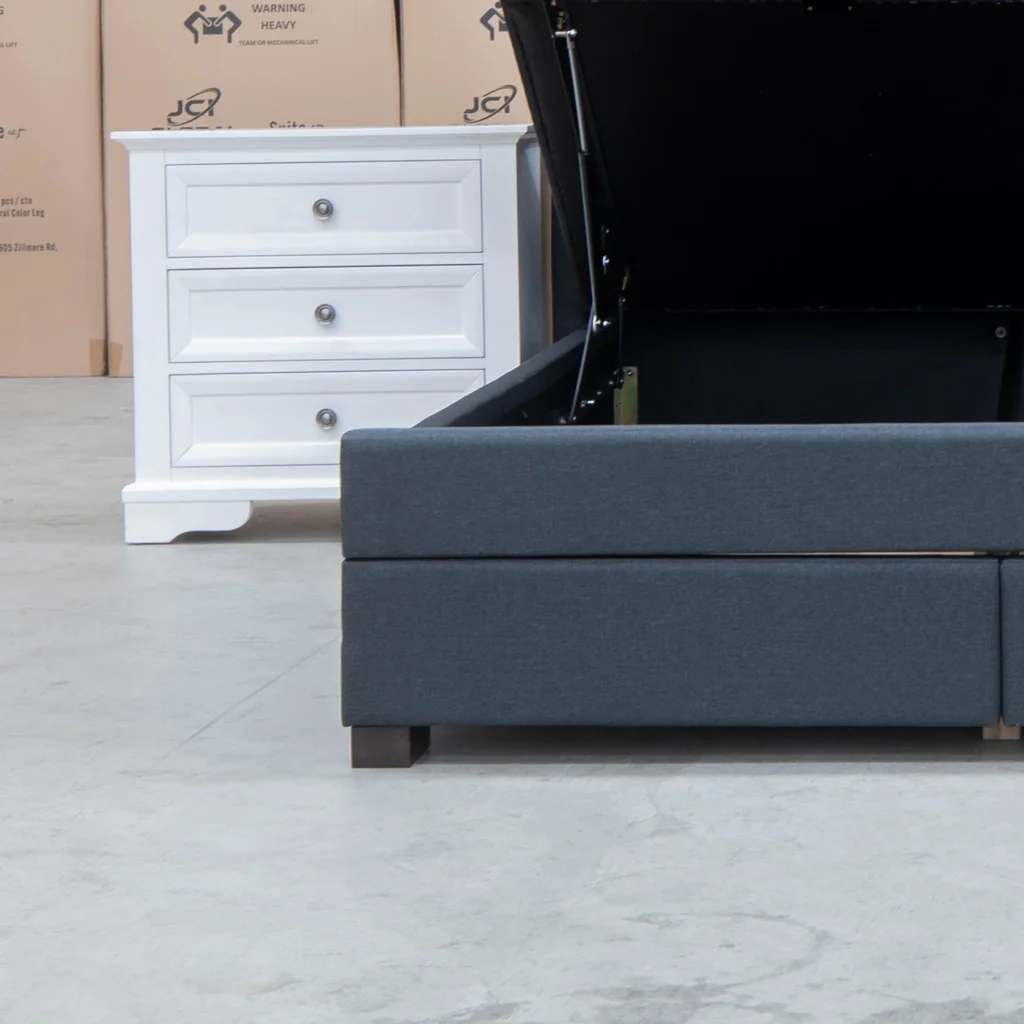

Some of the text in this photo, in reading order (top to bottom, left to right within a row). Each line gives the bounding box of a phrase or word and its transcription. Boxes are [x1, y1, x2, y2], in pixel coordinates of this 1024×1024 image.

[252, 3, 304, 13] WARNING
[261, 20, 295, 30] HEAVY
[167, 98, 214, 118] JCI
[464, 96, 510, 114] JCI
[32, 208, 44, 218] Leg
